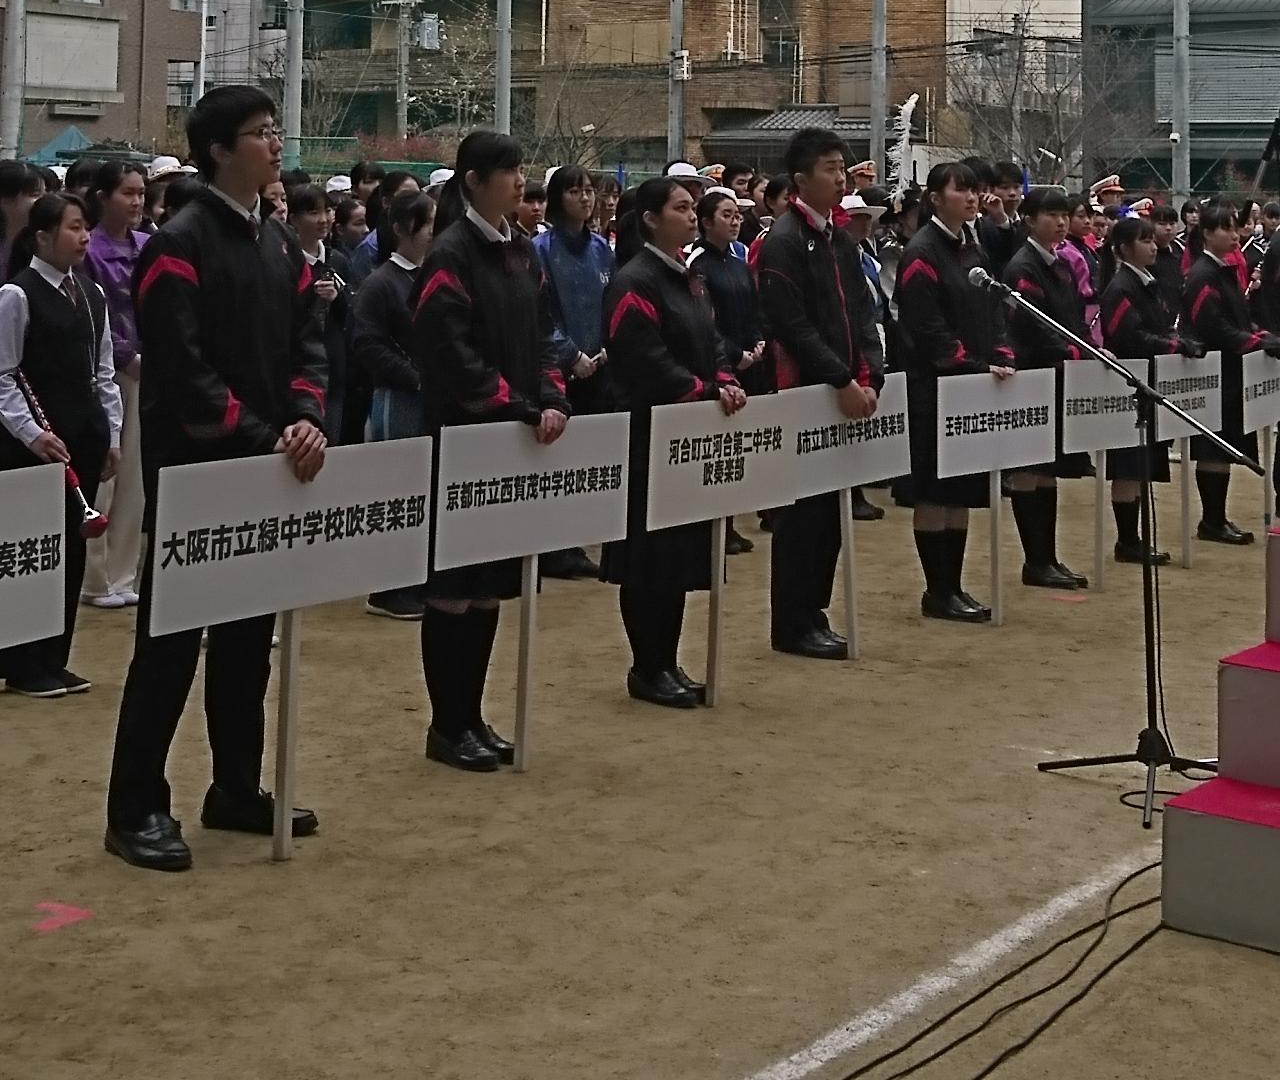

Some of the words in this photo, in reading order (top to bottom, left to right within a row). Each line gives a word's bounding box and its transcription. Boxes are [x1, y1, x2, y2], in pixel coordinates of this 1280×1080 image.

[946, 405, 1049, 437] 王寺町立王寺中学校吹奏楽部
[669, 425, 783, 465] 河合町立河合第二中学校
[446, 464, 622, 512] 京都市立西賀茂中学校吹奏楽部
[703, 456, 745, 486] 吹奏楽部
[161, 494, 426, 569] 大阪市立緑中学校吹奏楽部
